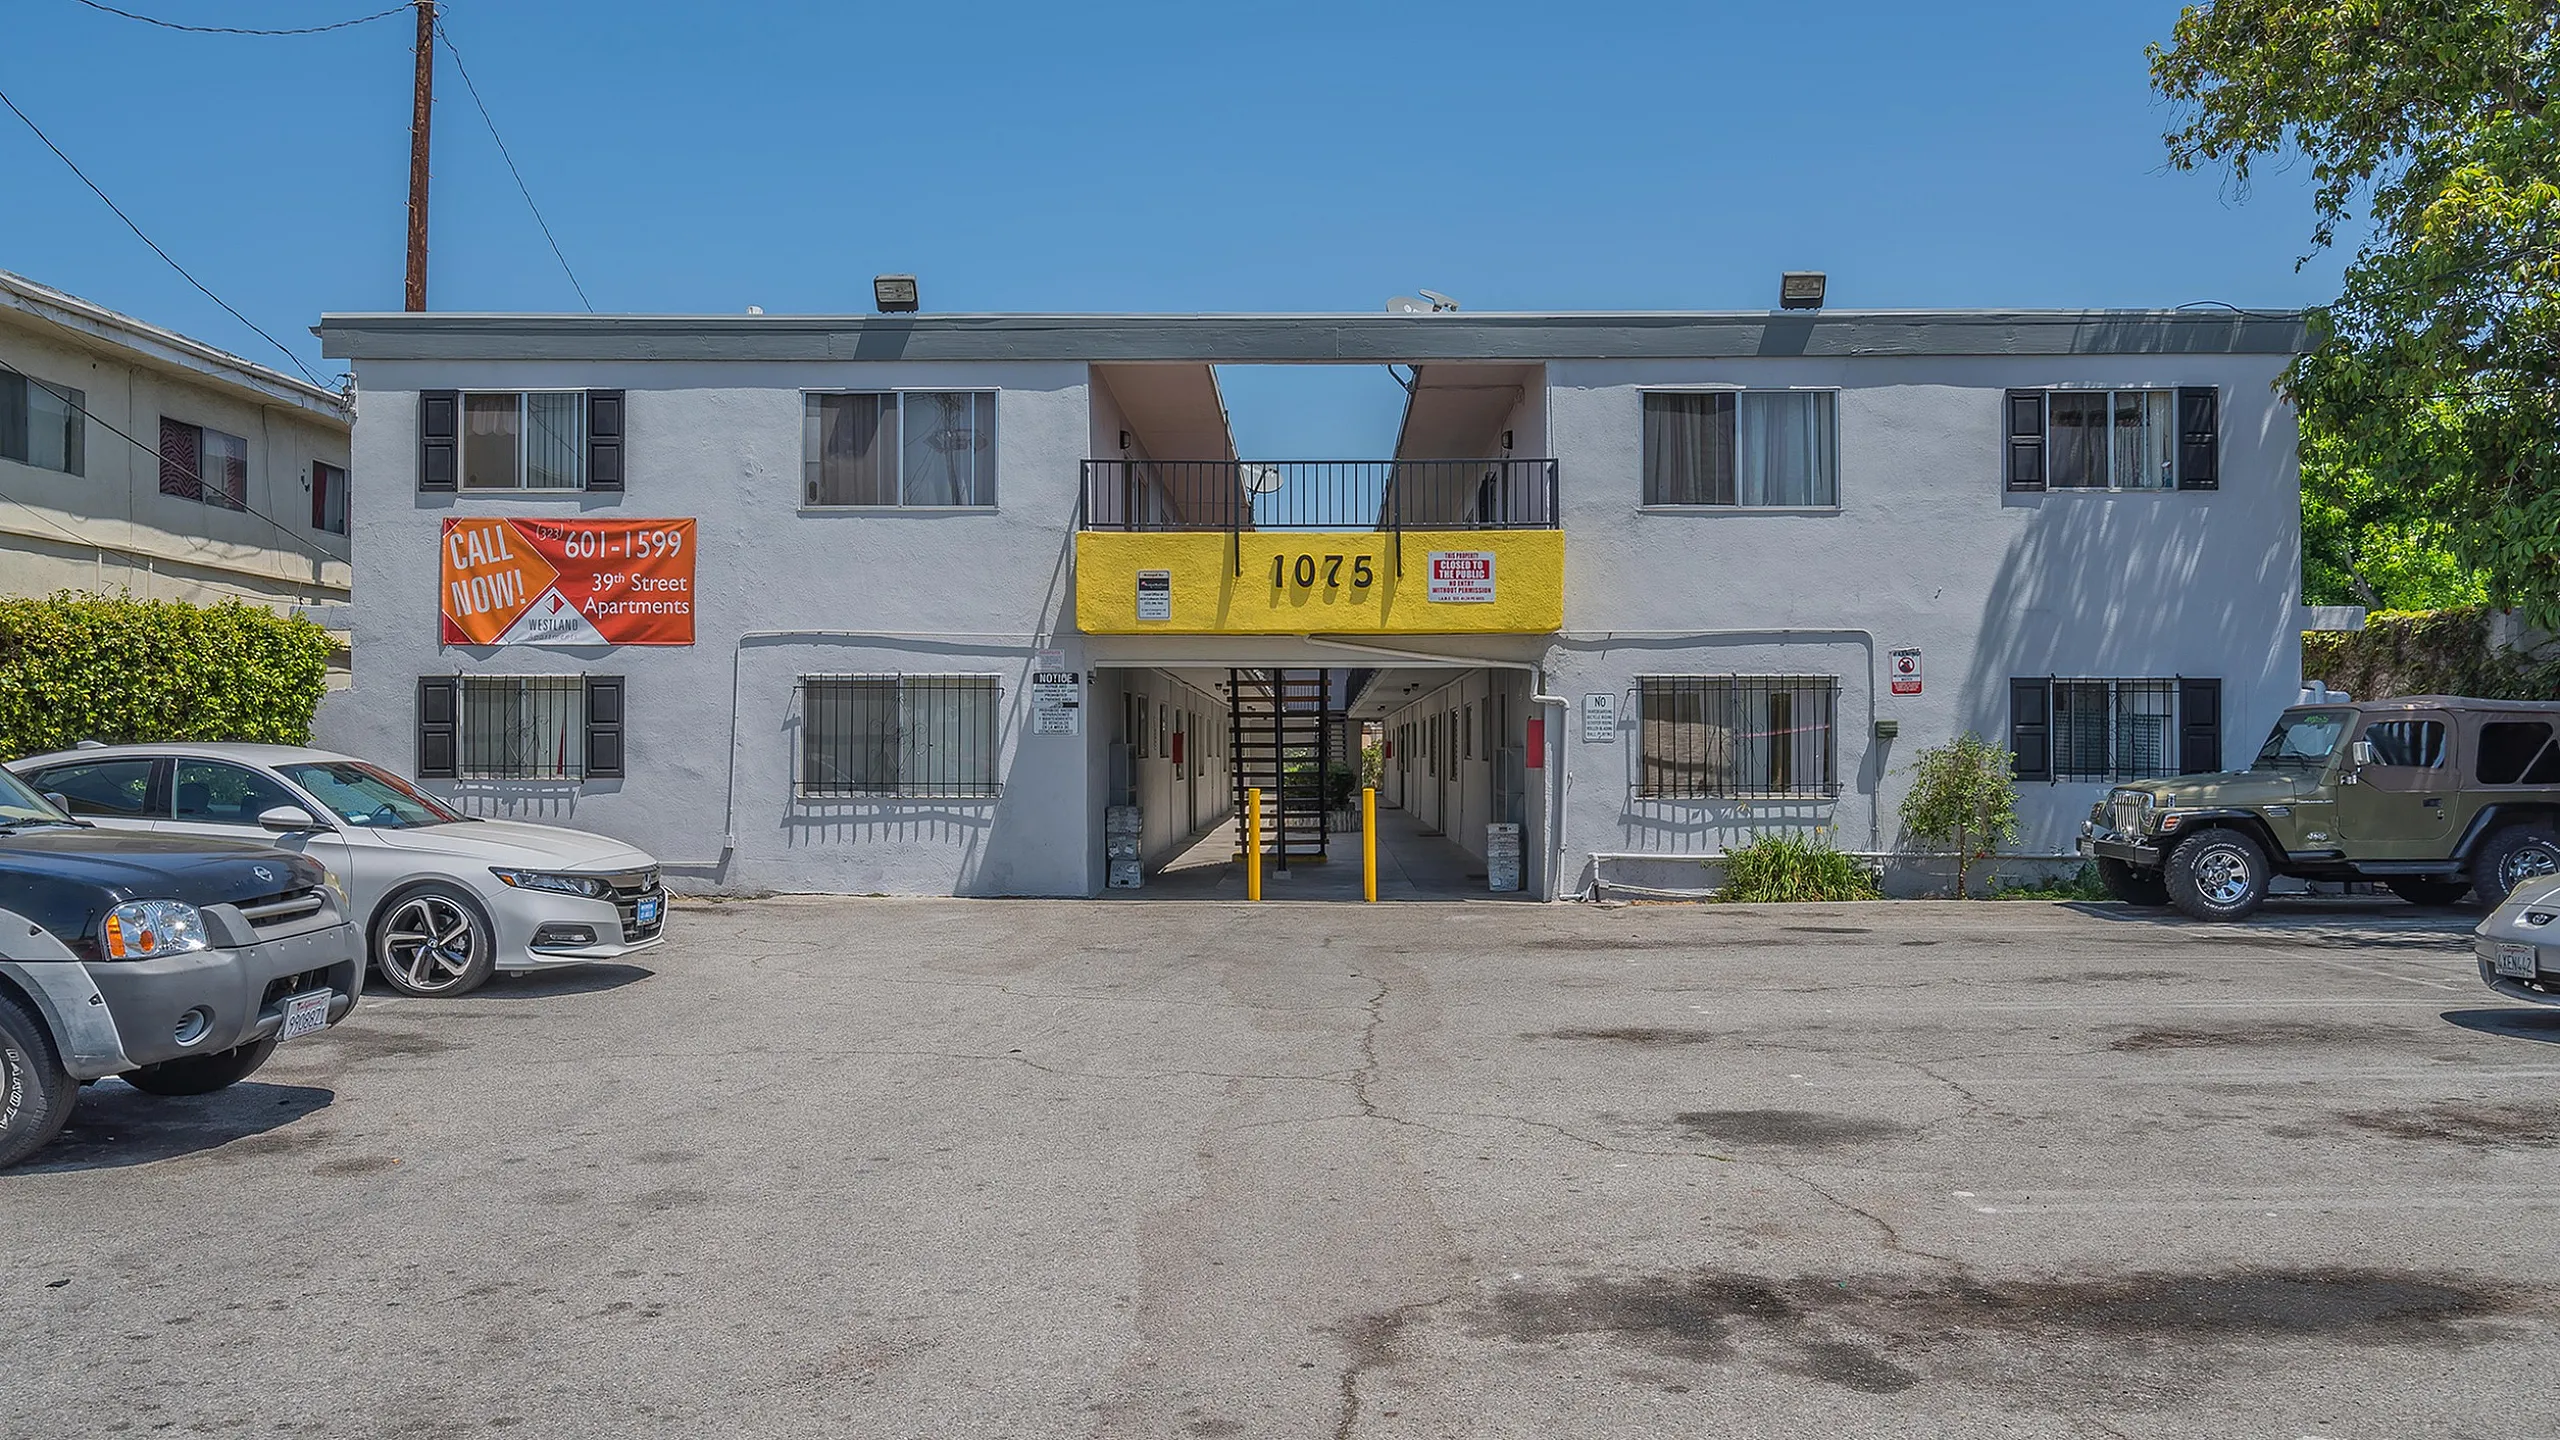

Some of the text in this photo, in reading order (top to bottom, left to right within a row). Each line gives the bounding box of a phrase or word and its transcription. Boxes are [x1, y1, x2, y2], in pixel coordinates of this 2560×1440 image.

[451, 525, 514, 570] CALL
[536, 523, 682, 559] (323) 601-1599
[1274, 554, 1374, 588] 1075
[1439, 570, 1485, 579] THE PUBLIC
[1440, 560, 1483, 570] CLOSED TO
[592, 573, 687, 592] 39th Street
[451, 569, 526, 618] NOW!
[583, 597, 689, 619] Apartments
[528, 618, 578, 631] WESTLAND
[1039, 673, 1073, 683] NOTICE
[1594, 696, 1606, 707] NO
